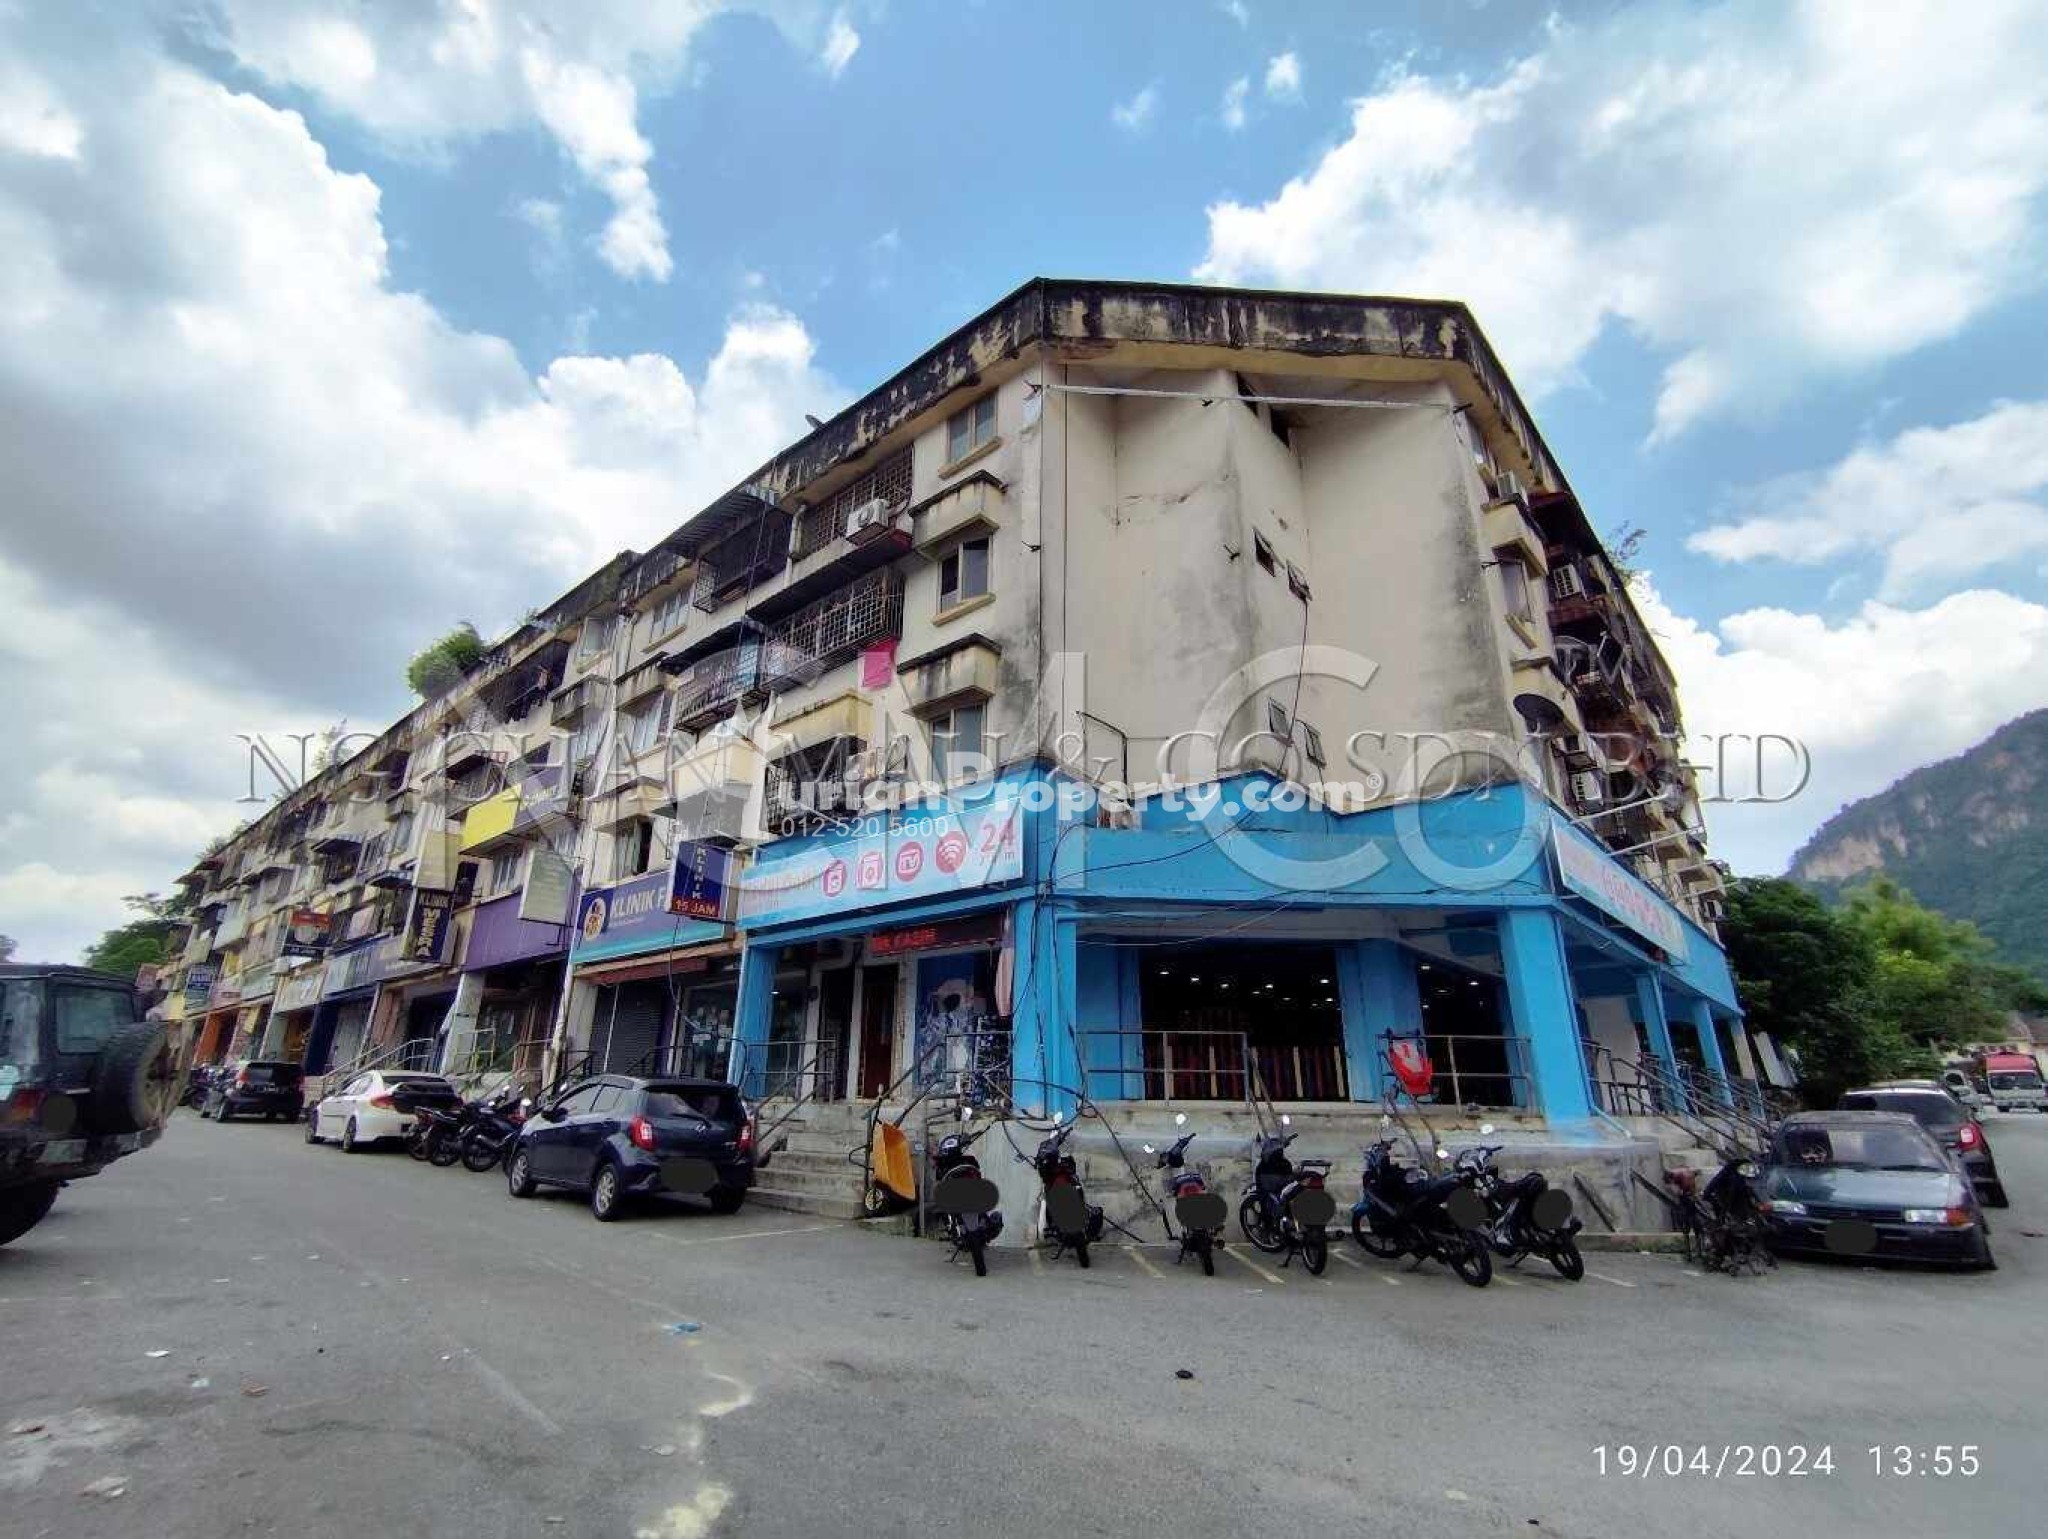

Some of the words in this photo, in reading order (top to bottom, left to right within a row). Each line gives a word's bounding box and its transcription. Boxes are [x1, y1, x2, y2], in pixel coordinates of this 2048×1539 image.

[980, 818, 1015, 853] 24
[609, 888, 656, 918] KLINIK
[691, 901, 718, 916] JAM
